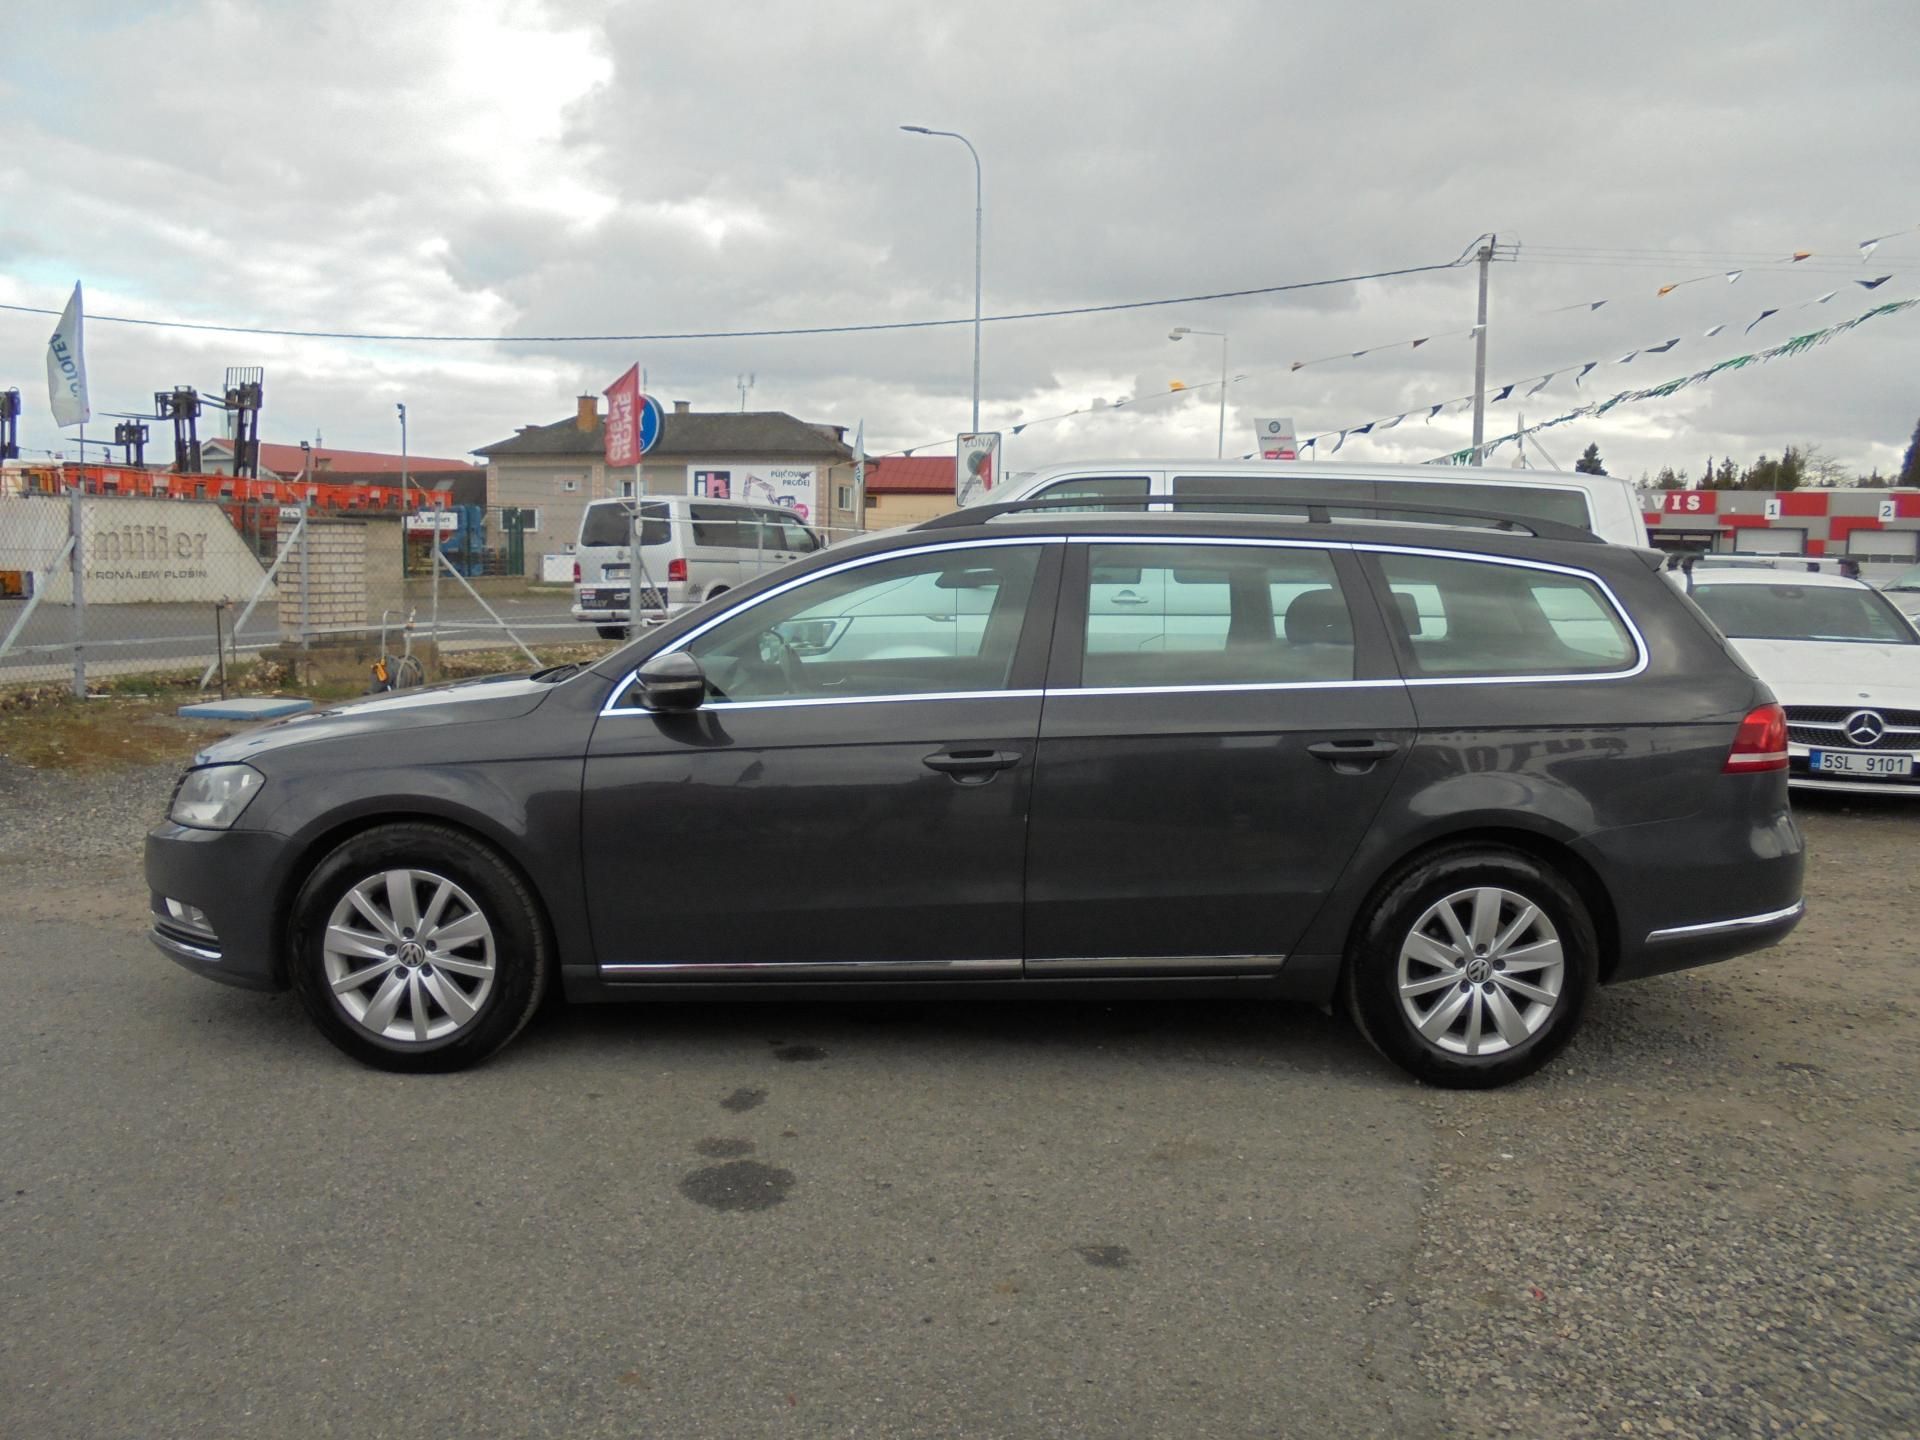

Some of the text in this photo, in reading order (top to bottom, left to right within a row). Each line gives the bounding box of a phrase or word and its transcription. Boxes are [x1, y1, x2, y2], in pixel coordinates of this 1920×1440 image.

[1637, 494, 1701, 511] RVIS
[1768, 503, 1777, 515] 1
[1881, 505, 1892, 517] 2
[1823, 754, 1905, 773] 5SL 9101
